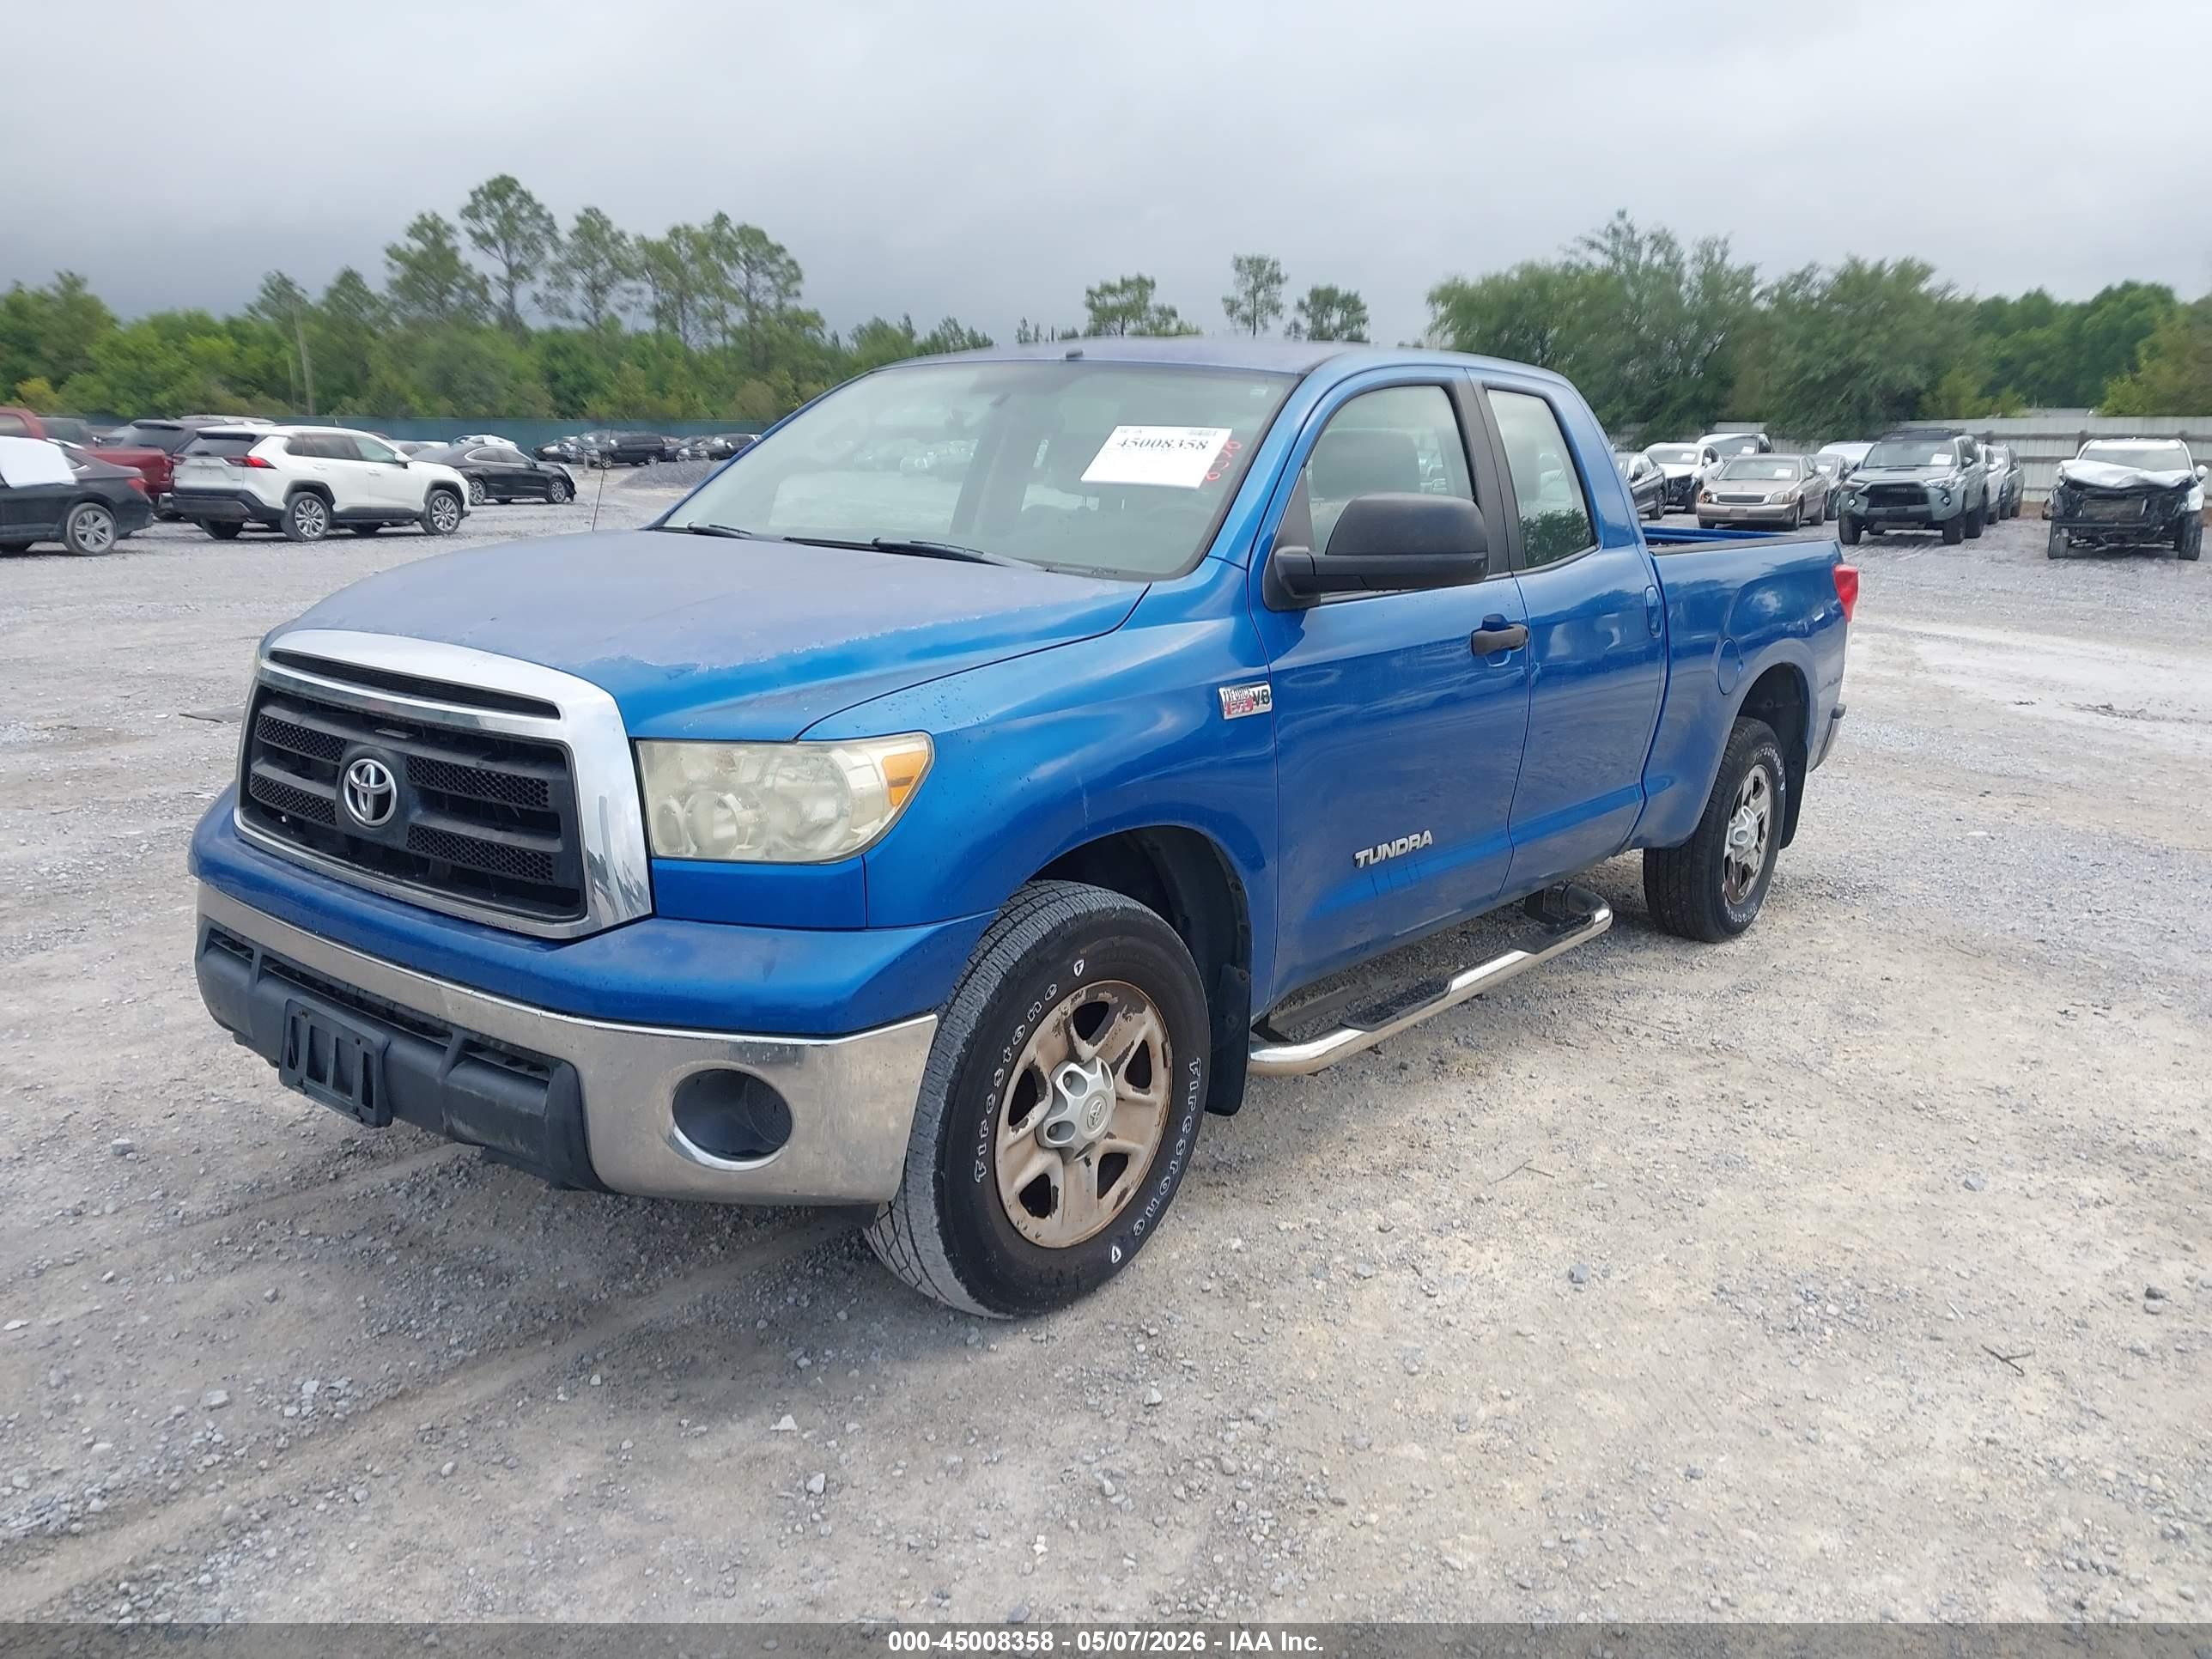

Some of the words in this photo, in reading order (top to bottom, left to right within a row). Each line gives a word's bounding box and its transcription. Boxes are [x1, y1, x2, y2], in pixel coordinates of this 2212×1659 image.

[1118, 437, 1208, 450] 45008358
[1253, 689, 1271, 707] V8
[1353, 829, 1433, 869] TUNDRA
[974, 983, 1058, 1183] Firestone
[1133, 1057, 1201, 1237] Firestone
